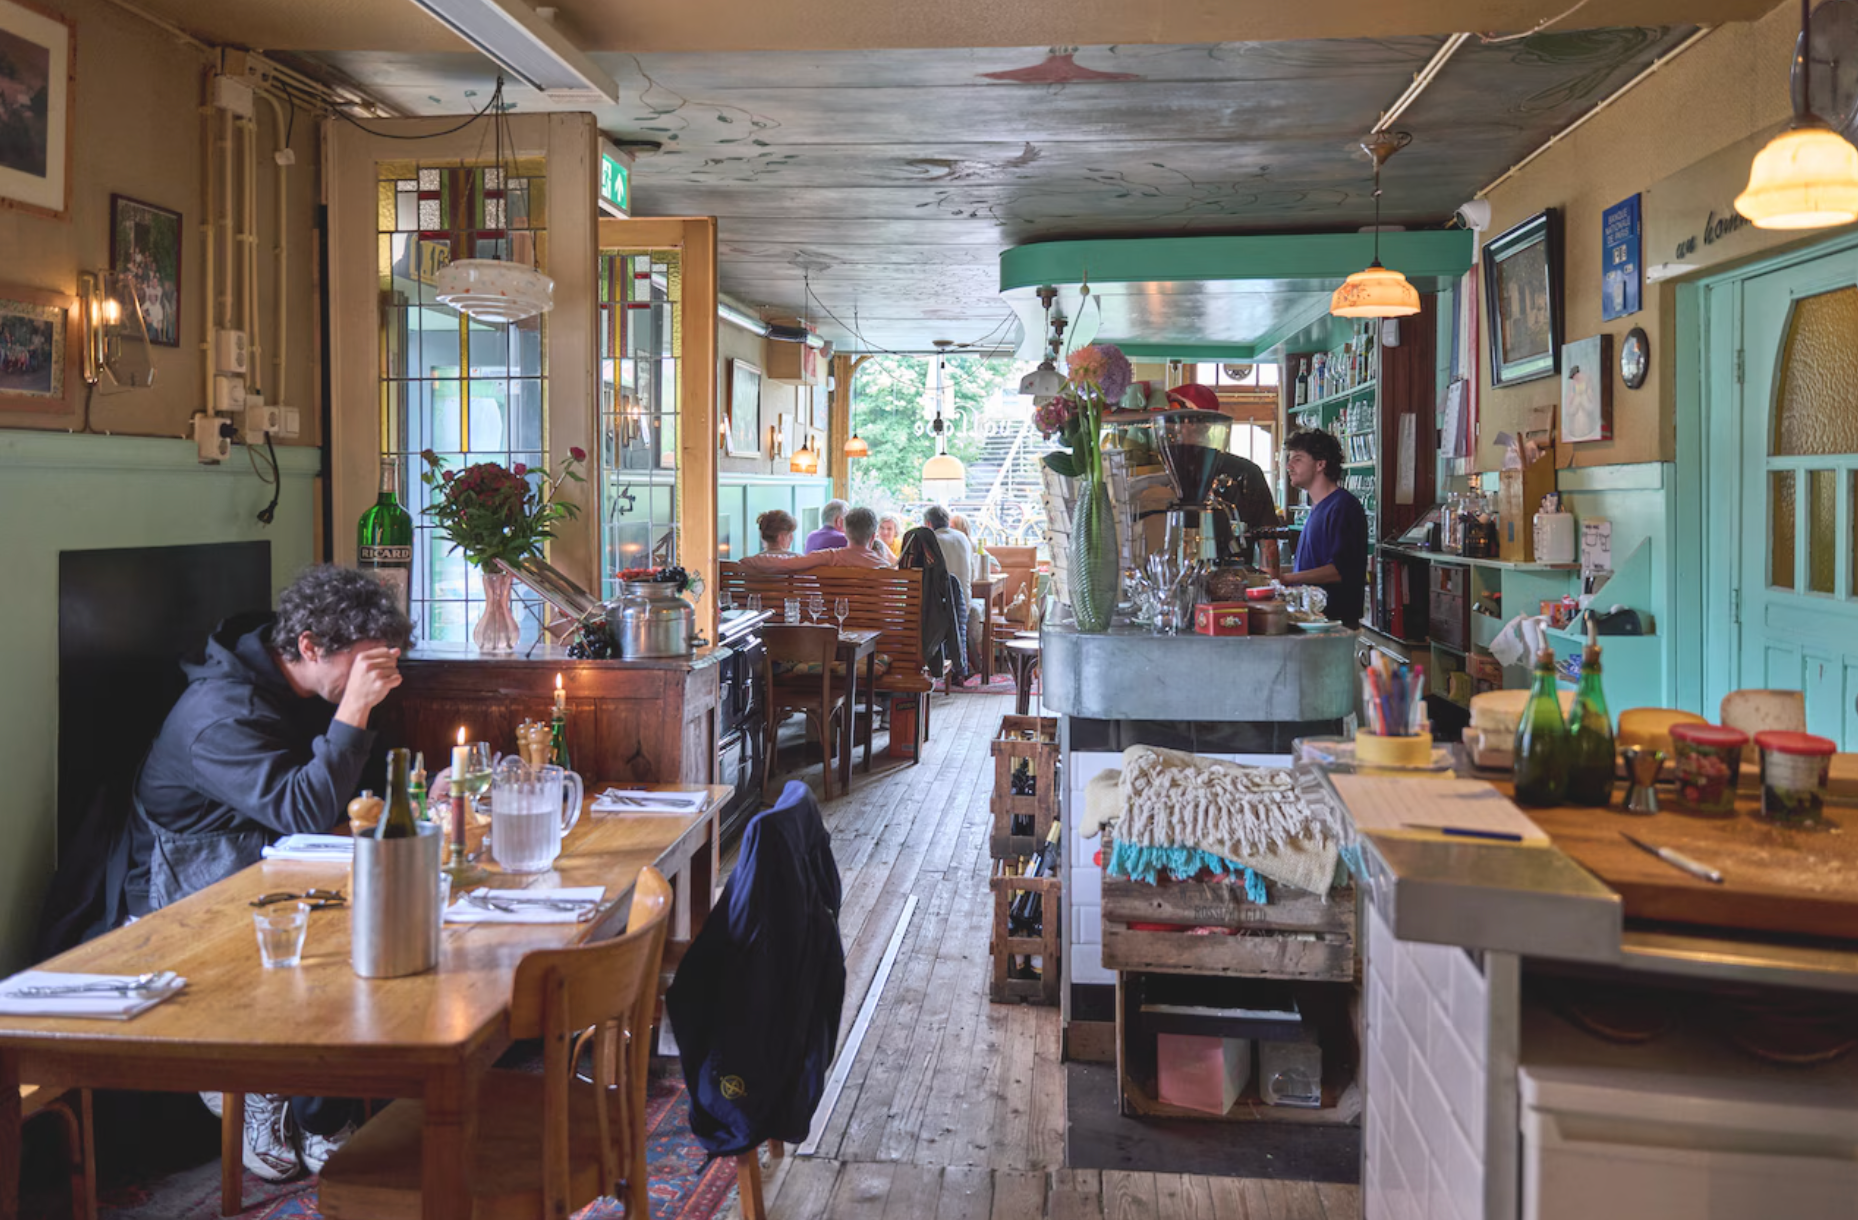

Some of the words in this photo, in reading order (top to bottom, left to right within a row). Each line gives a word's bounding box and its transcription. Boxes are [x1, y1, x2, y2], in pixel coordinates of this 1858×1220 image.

[1608, 207, 1628, 225] BANQUE
[1605, 216, 1631, 235] NATIONALE
[361, 549, 410, 558] RICARD
